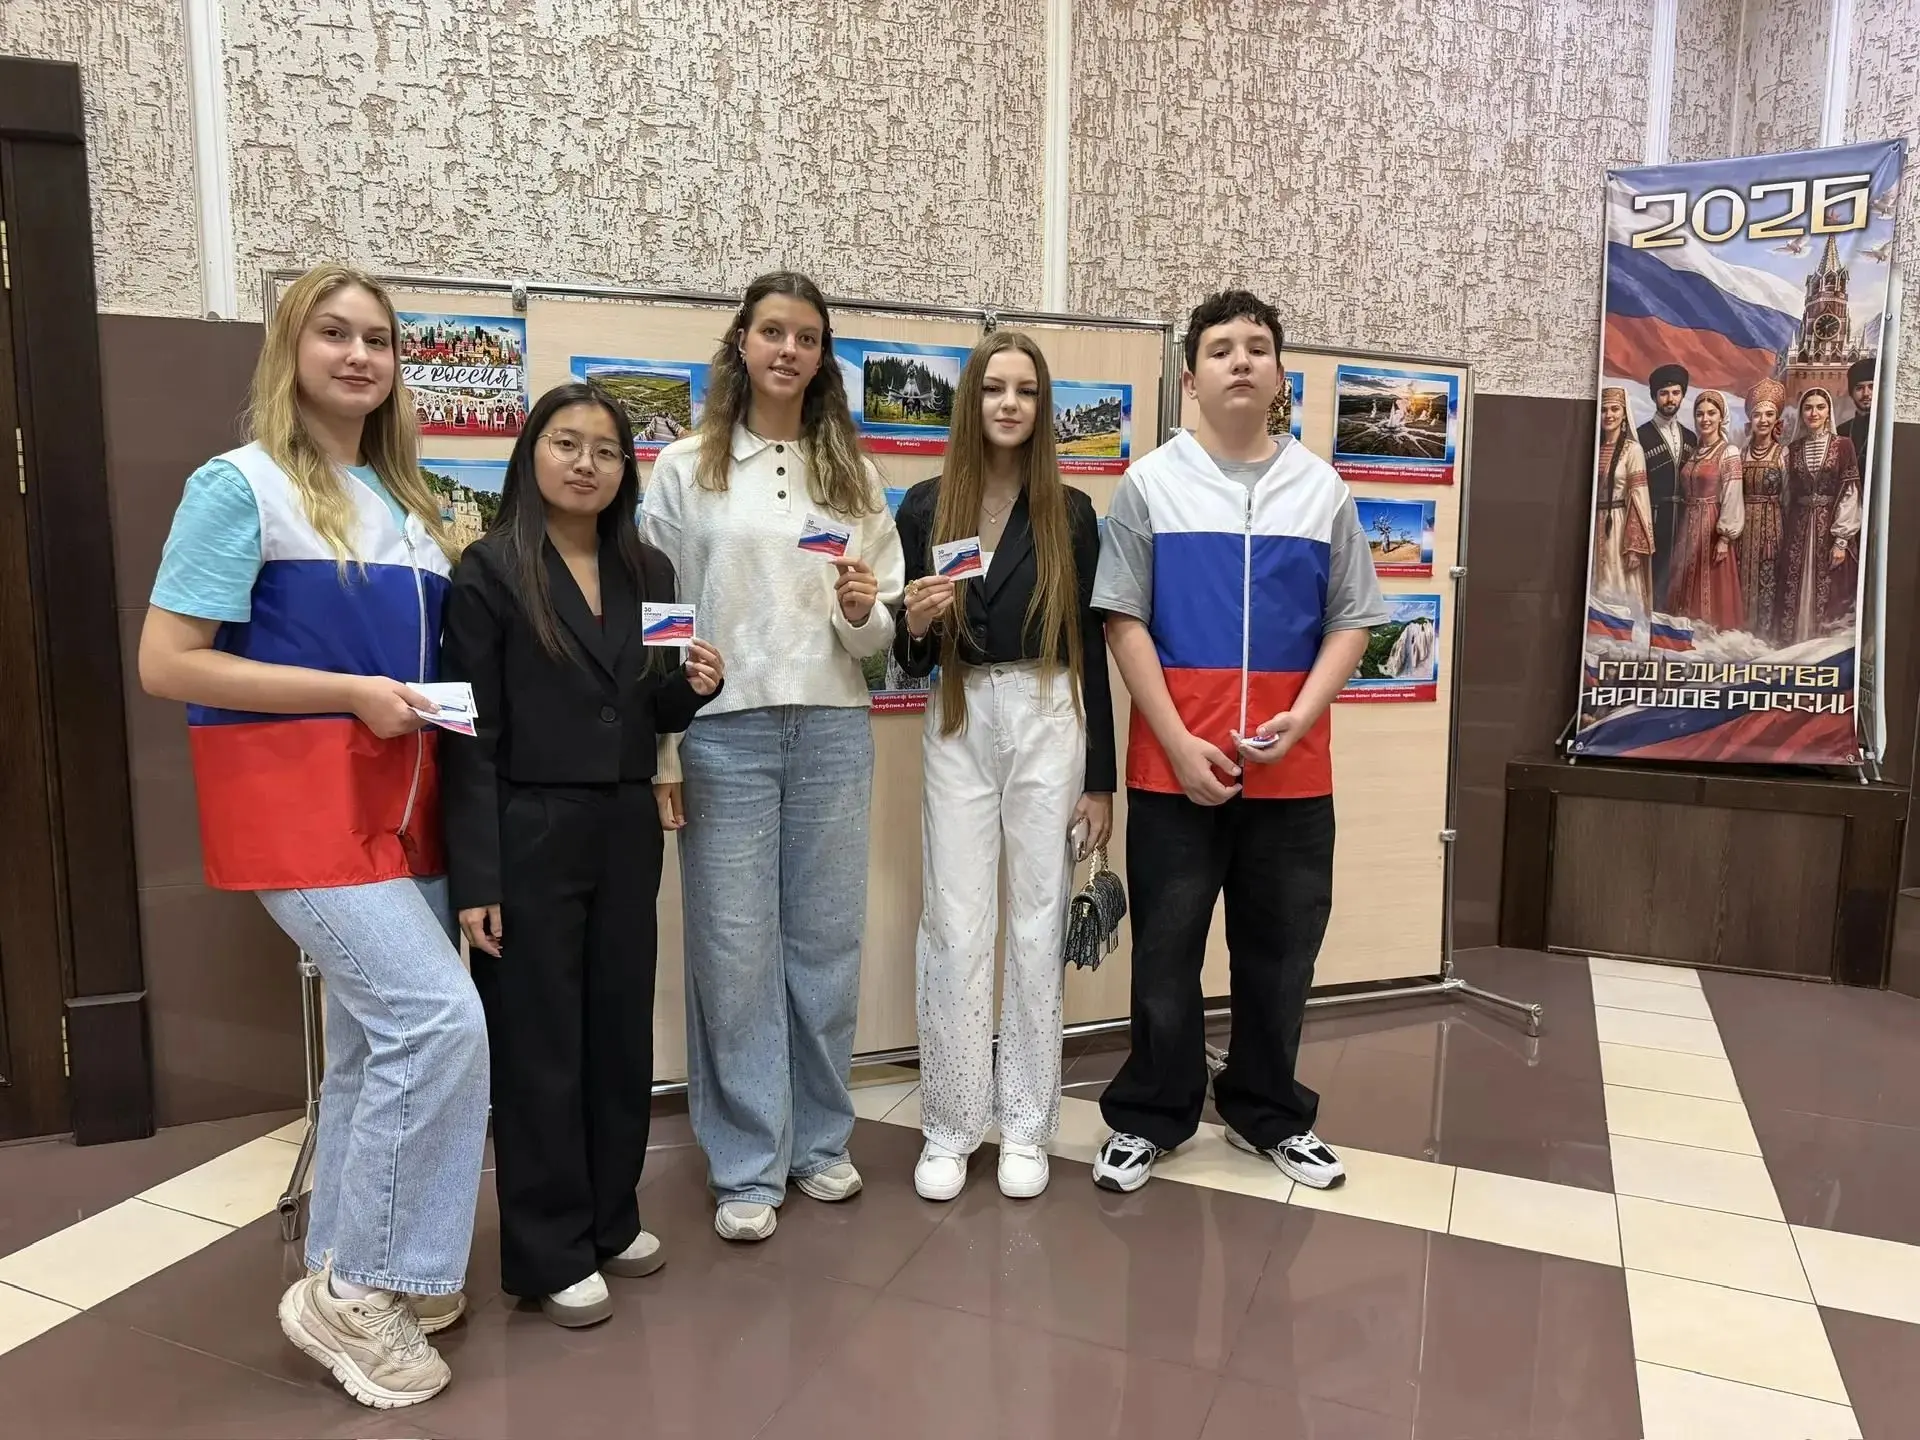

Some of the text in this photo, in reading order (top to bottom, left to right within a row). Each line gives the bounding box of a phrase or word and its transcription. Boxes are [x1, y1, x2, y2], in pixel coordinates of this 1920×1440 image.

[1632, 174, 1871, 248] 2026
[402, 364, 514, 388] СЕ РОССИЯ
[1599, 661, 1658, 681] ГОД
[1665, 662, 1839, 688] ЕДИНСТВА
